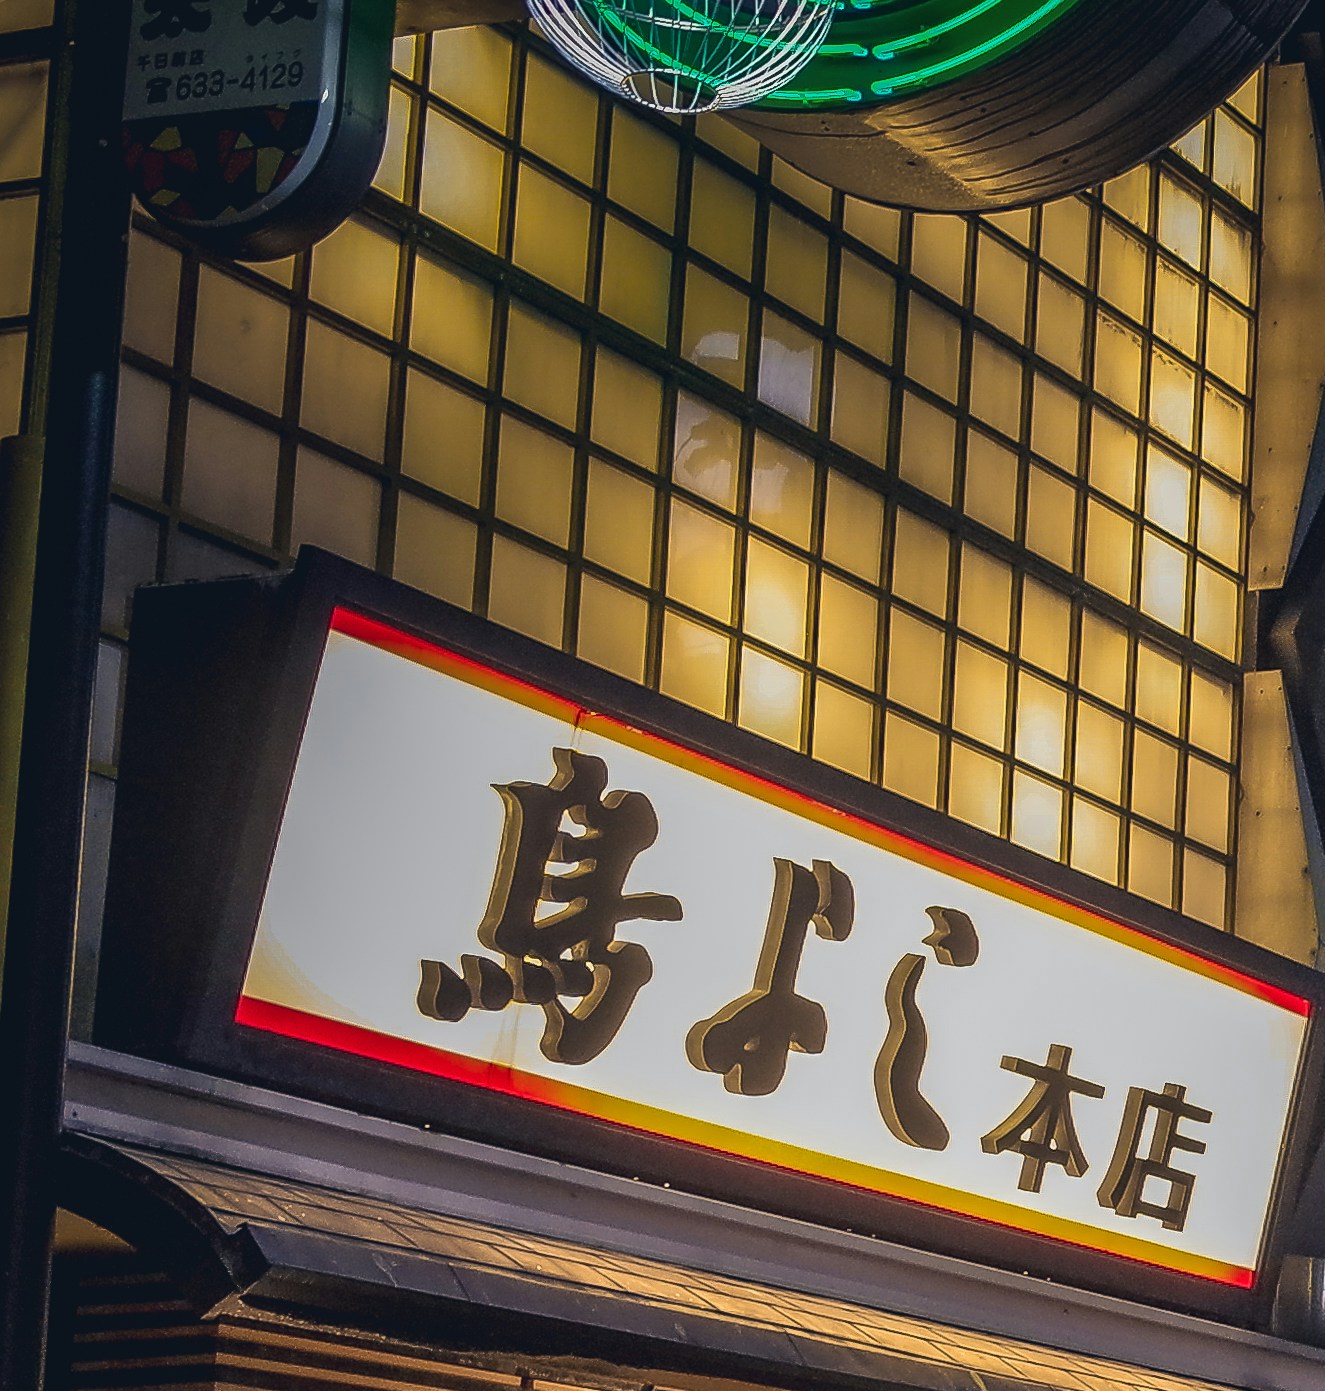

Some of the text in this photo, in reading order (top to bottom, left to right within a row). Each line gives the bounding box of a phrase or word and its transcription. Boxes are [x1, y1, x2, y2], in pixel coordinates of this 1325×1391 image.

[176, 61, 304, 100] 633-4129
[417, 747, 1213, 1231] 鳥よし本店
